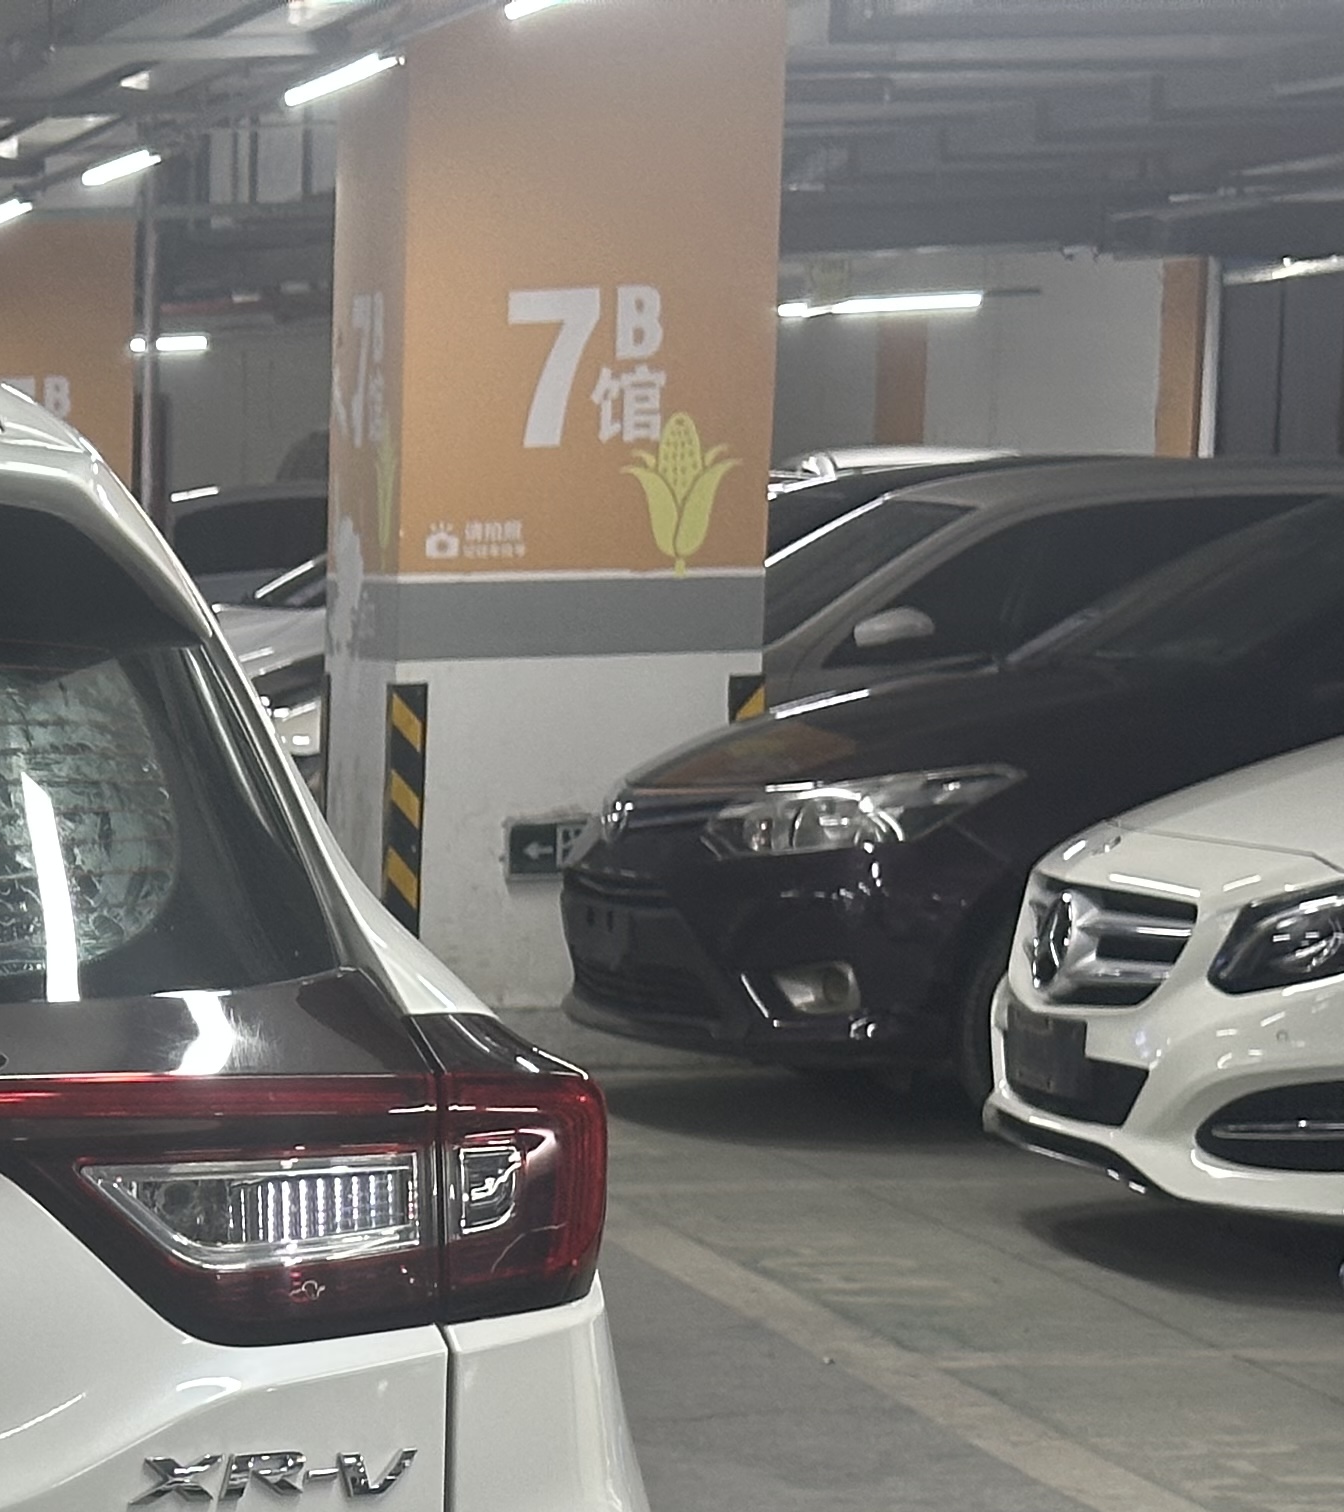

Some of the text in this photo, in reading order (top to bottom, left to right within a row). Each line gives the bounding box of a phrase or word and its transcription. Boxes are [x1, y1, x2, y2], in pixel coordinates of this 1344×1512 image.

[507, 284, 664, 448] 7 B
[591, 364, 667, 445] 馆
[126, 1447, 418, 1506] XR-V
